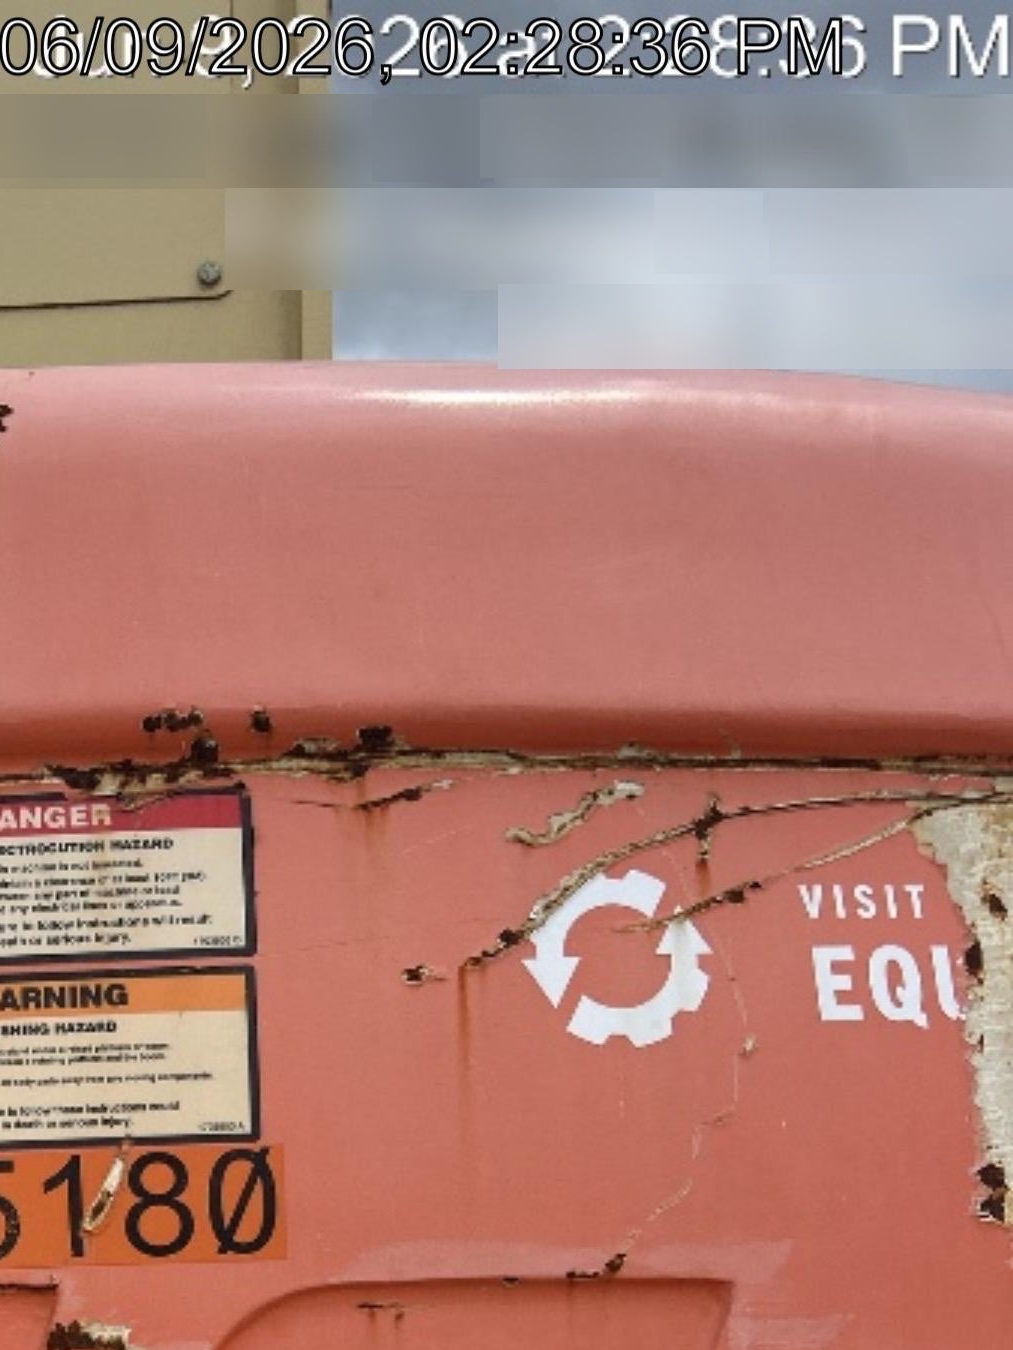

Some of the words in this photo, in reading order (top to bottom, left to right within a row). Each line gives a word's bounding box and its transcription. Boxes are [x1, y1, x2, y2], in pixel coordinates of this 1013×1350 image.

[109, 837, 174, 852] HAZARD
[797, 883, 925, 919] VISIT
[54, 1020, 118, 1035] HAZARD
